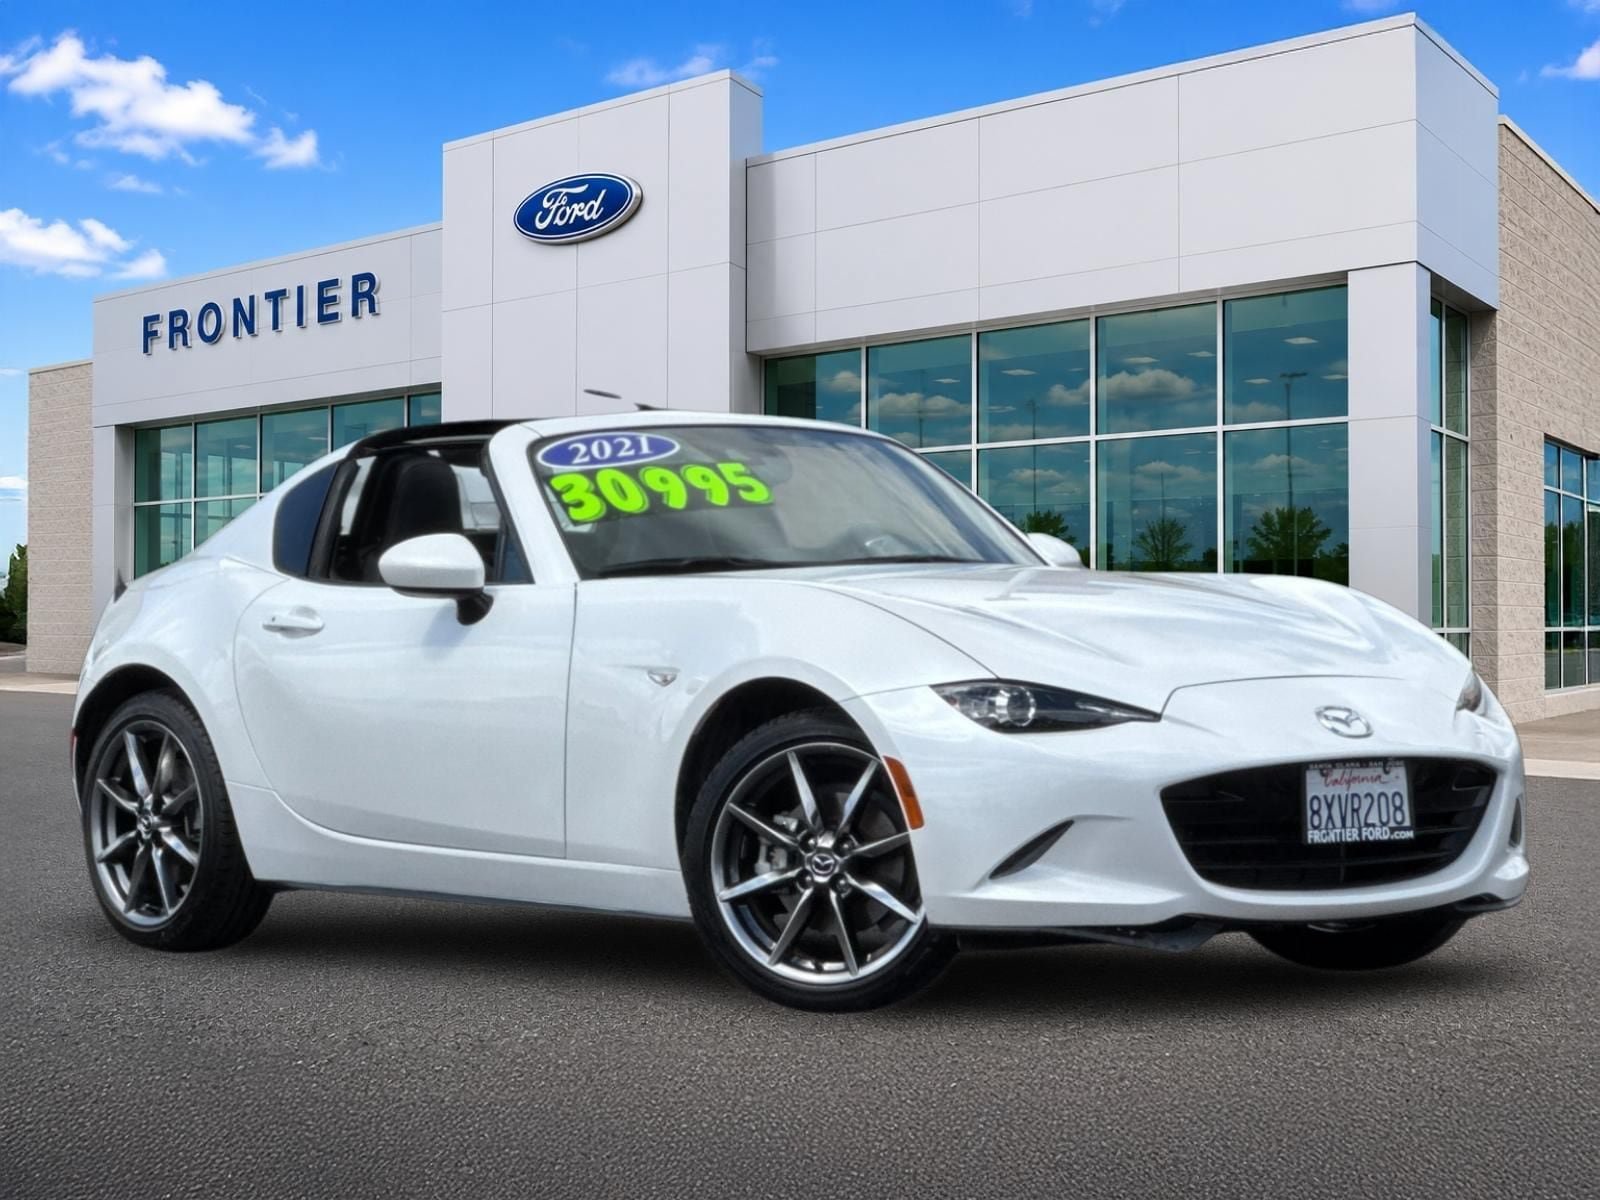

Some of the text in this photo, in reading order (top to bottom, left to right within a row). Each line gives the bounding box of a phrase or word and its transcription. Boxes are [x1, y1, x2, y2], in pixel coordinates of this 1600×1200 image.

[535, 184, 607, 230] Ford
[142, 271, 380, 355] FRONTIER
[568, 436, 654, 465] 2021
[550, 463, 773, 522] 30995
[1324, 769, 1390, 791] California
[1309, 791, 1405, 829] 8XVR208
[1307, 828, 1360, 844] FRONTIER
